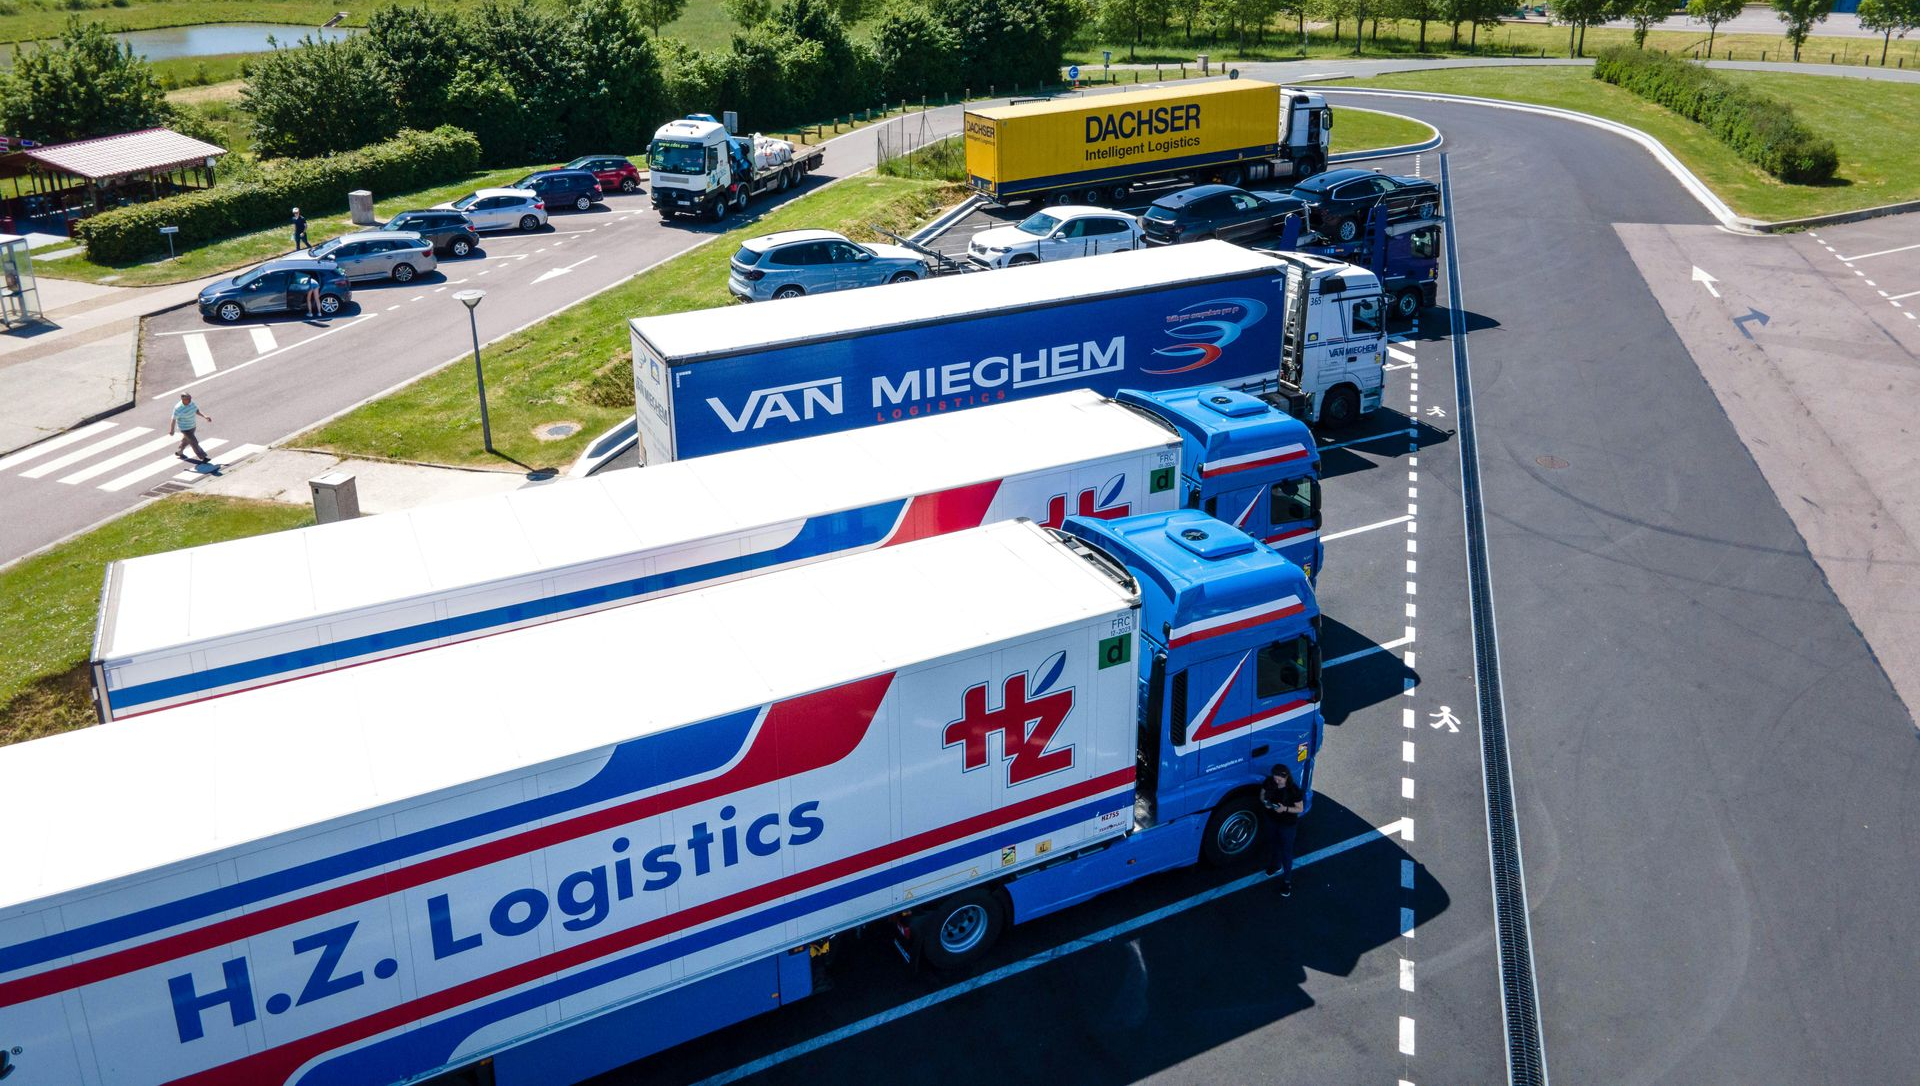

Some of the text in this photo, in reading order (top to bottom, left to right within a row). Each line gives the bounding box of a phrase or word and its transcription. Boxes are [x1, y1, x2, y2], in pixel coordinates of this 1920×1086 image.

[966, 120, 995, 138] DACHSER
[1085, 103, 1201, 144] DACHSER
[1085, 136, 1201, 161] Intelligent Logistics
[1310, 297, 1322, 306] 365
[1329, 343, 1378, 358] VAN MIEGHEM
[706, 336, 1125, 433] VAN MIEGHEM
[877, 390, 1005, 422] LOGISTICS
[1160, 453, 1174, 463] FRC
[1156, 470, 1169, 490] d
[1111, 616, 1130, 630] FRC
[1107, 638, 1123, 665] d
[943, 671, 1076, 788] HZ
[167, 800, 825, 1044] H.Z. Logistics
